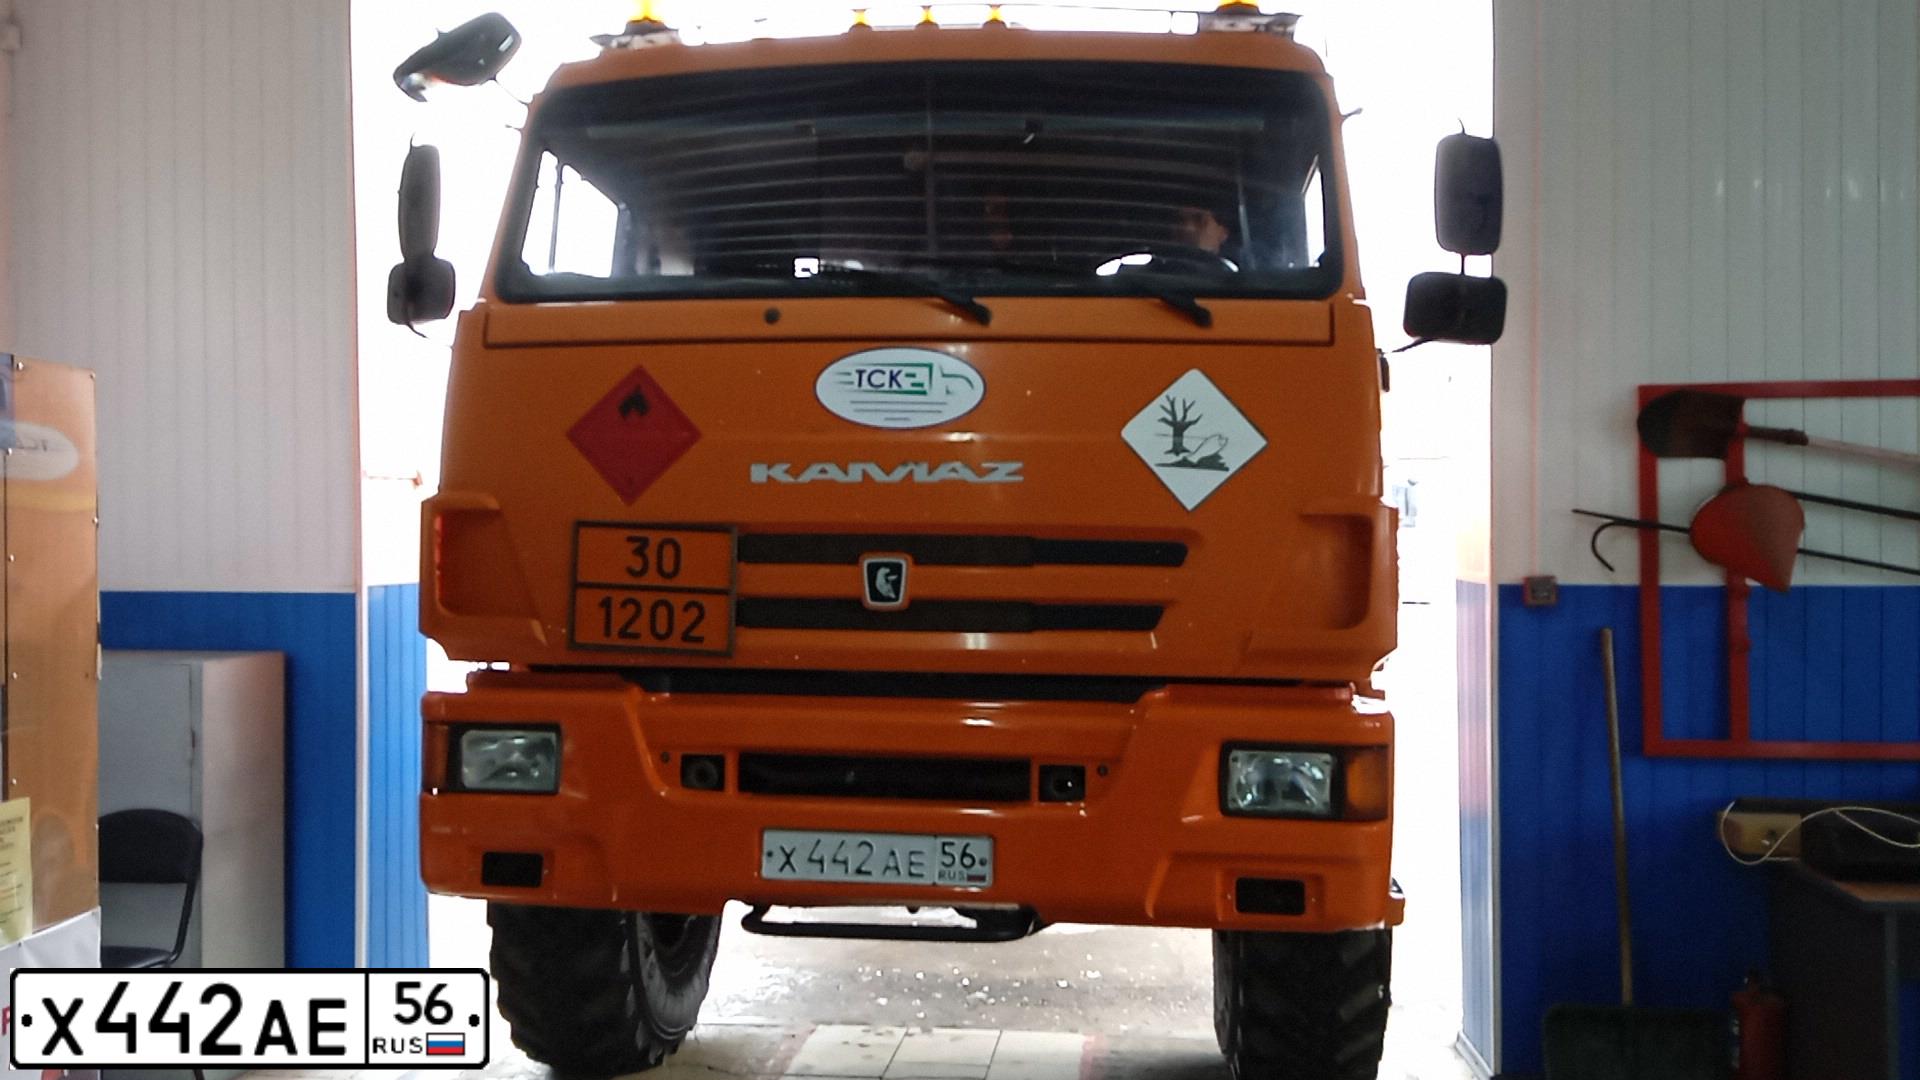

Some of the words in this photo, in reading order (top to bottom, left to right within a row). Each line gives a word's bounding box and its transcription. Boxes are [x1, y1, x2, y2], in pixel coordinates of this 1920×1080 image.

[750, 461, 1024, 483] KAMAZ
[625, 536, 682, 579] 30
[598, 596, 705, 643] 1202
[940, 841, 977, 869] 56
[938, 870, 965, 881] RUS
